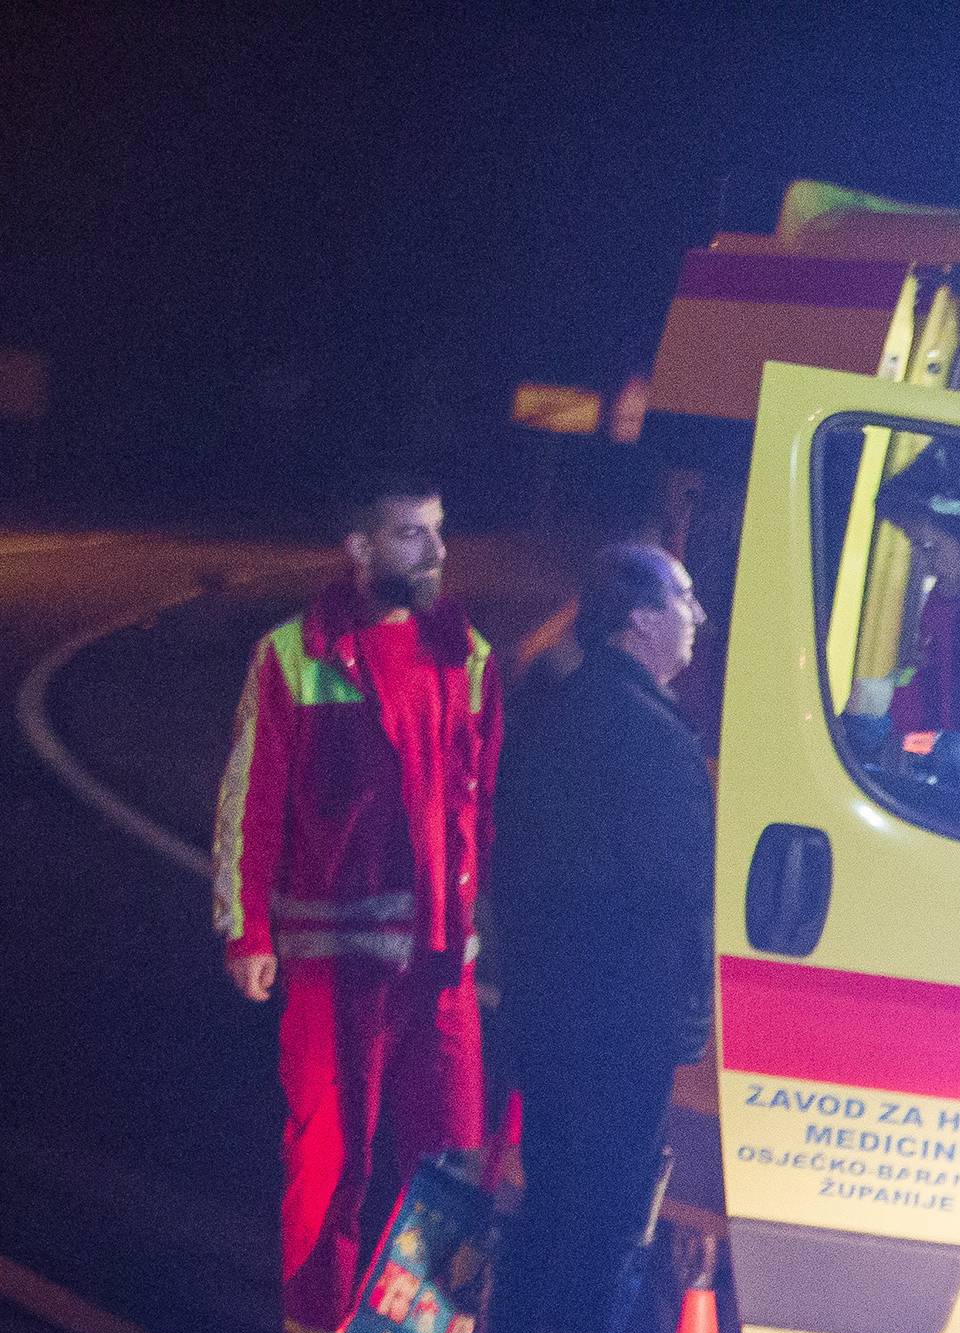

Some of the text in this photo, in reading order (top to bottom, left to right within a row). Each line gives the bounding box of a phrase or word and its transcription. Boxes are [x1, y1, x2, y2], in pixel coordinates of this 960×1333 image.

[745, 1084, 866, 1120] ZAVOD
[879, 1102, 924, 1129] ZA
[819, 1177, 956, 1212] ŽUPANIJE
